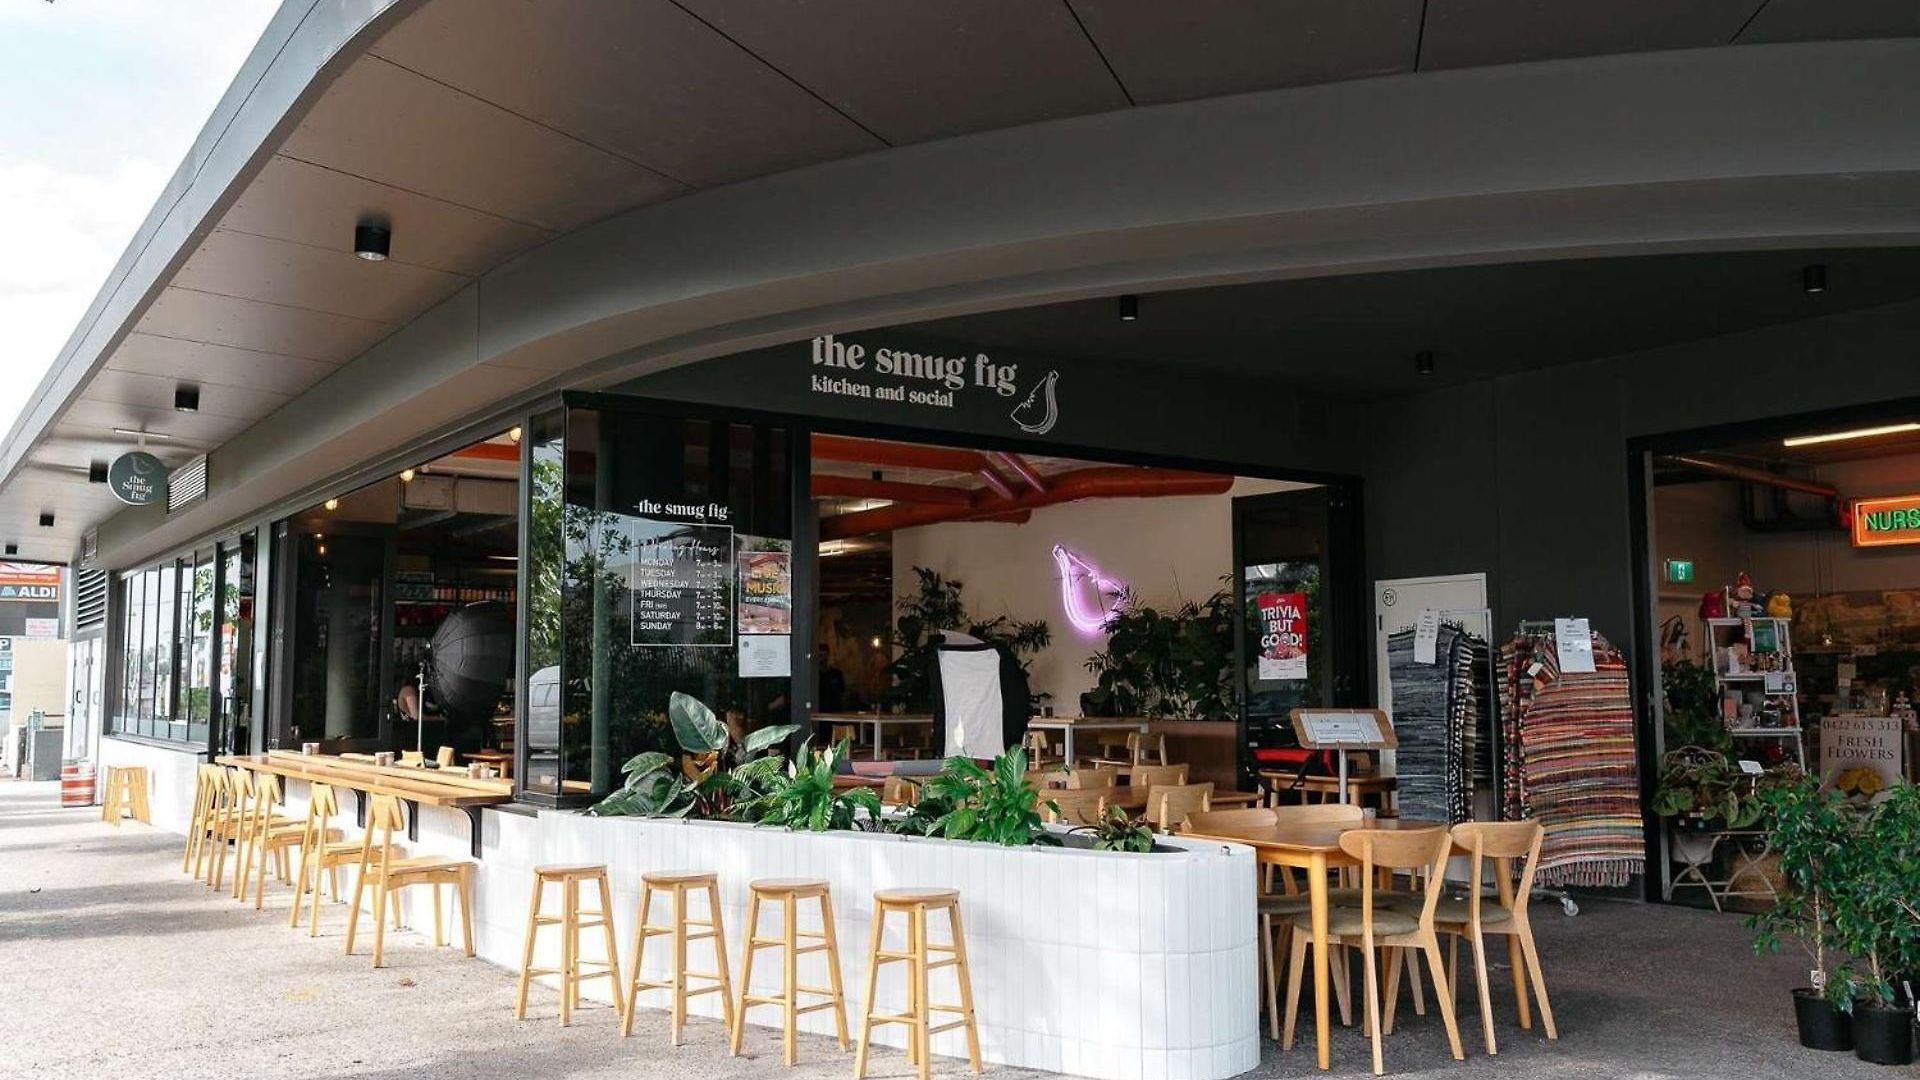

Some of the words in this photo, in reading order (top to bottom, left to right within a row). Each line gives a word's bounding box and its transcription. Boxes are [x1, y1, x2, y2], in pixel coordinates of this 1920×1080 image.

[811, 334, 865, 370] the
[875, 348, 966, 390] smug
[974, 353, 1017, 396] fig
[811, 375, 871, 398] kitchen
[875, 385, 905, 401] and
[909, 389, 953, 408] social
[129, 475, 145, 485] the
[638, 499, 662, 514] the
[665, 503, 705, 519] smug
[708, 503, 728, 520] fig
[640, 558, 674, 567] MONDAY
[19, 586, 56, 598] ALDI
[640, 590, 681, 599] THURSDAY
[640, 600, 654, 609] FRI
[640, 610, 681, 620] SATURDAY
[1261, 605, 1301, 621] TRIVIA
[640, 622, 672, 630] SUNDAY
[1270, 619, 1293, 633] BUT
[1838, 735, 1884, 748] FRESH
[1828, 746, 1895, 760] FLOWERS
